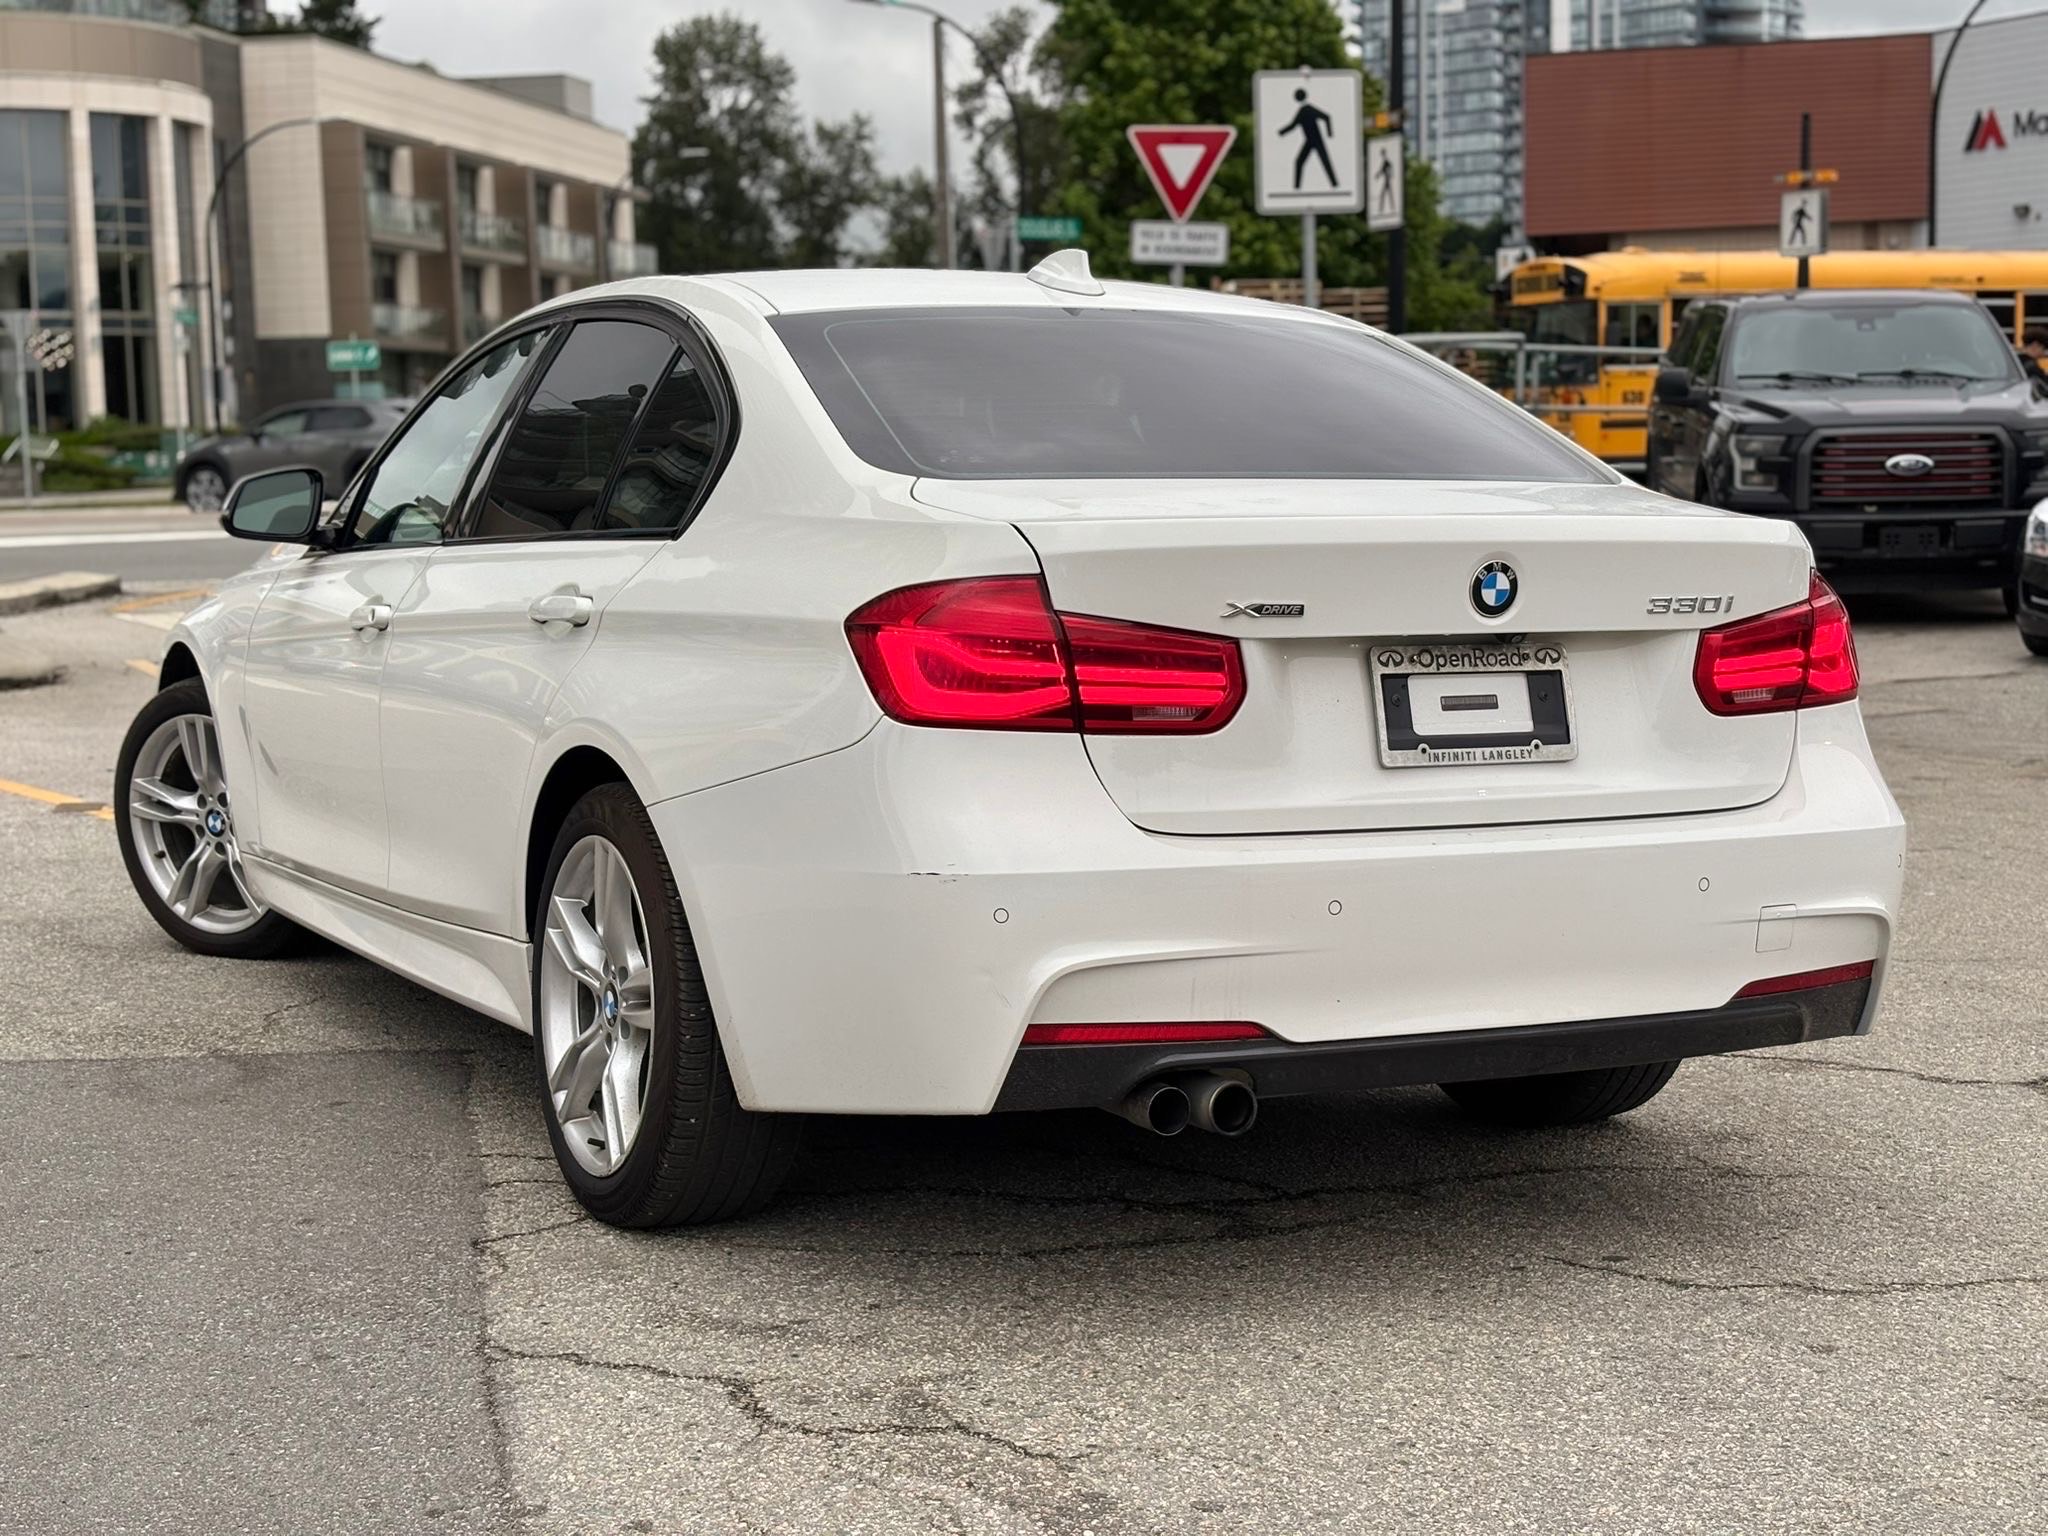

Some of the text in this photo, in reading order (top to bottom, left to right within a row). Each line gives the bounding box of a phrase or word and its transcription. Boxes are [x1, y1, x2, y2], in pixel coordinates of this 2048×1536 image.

[1477, 562, 1516, 581] BMW
[1646, 594, 1734, 615] 330i
[1418, 648, 1523, 670] OpenRoad
[1428, 748, 1533, 763] INFINITI LANGLEY
